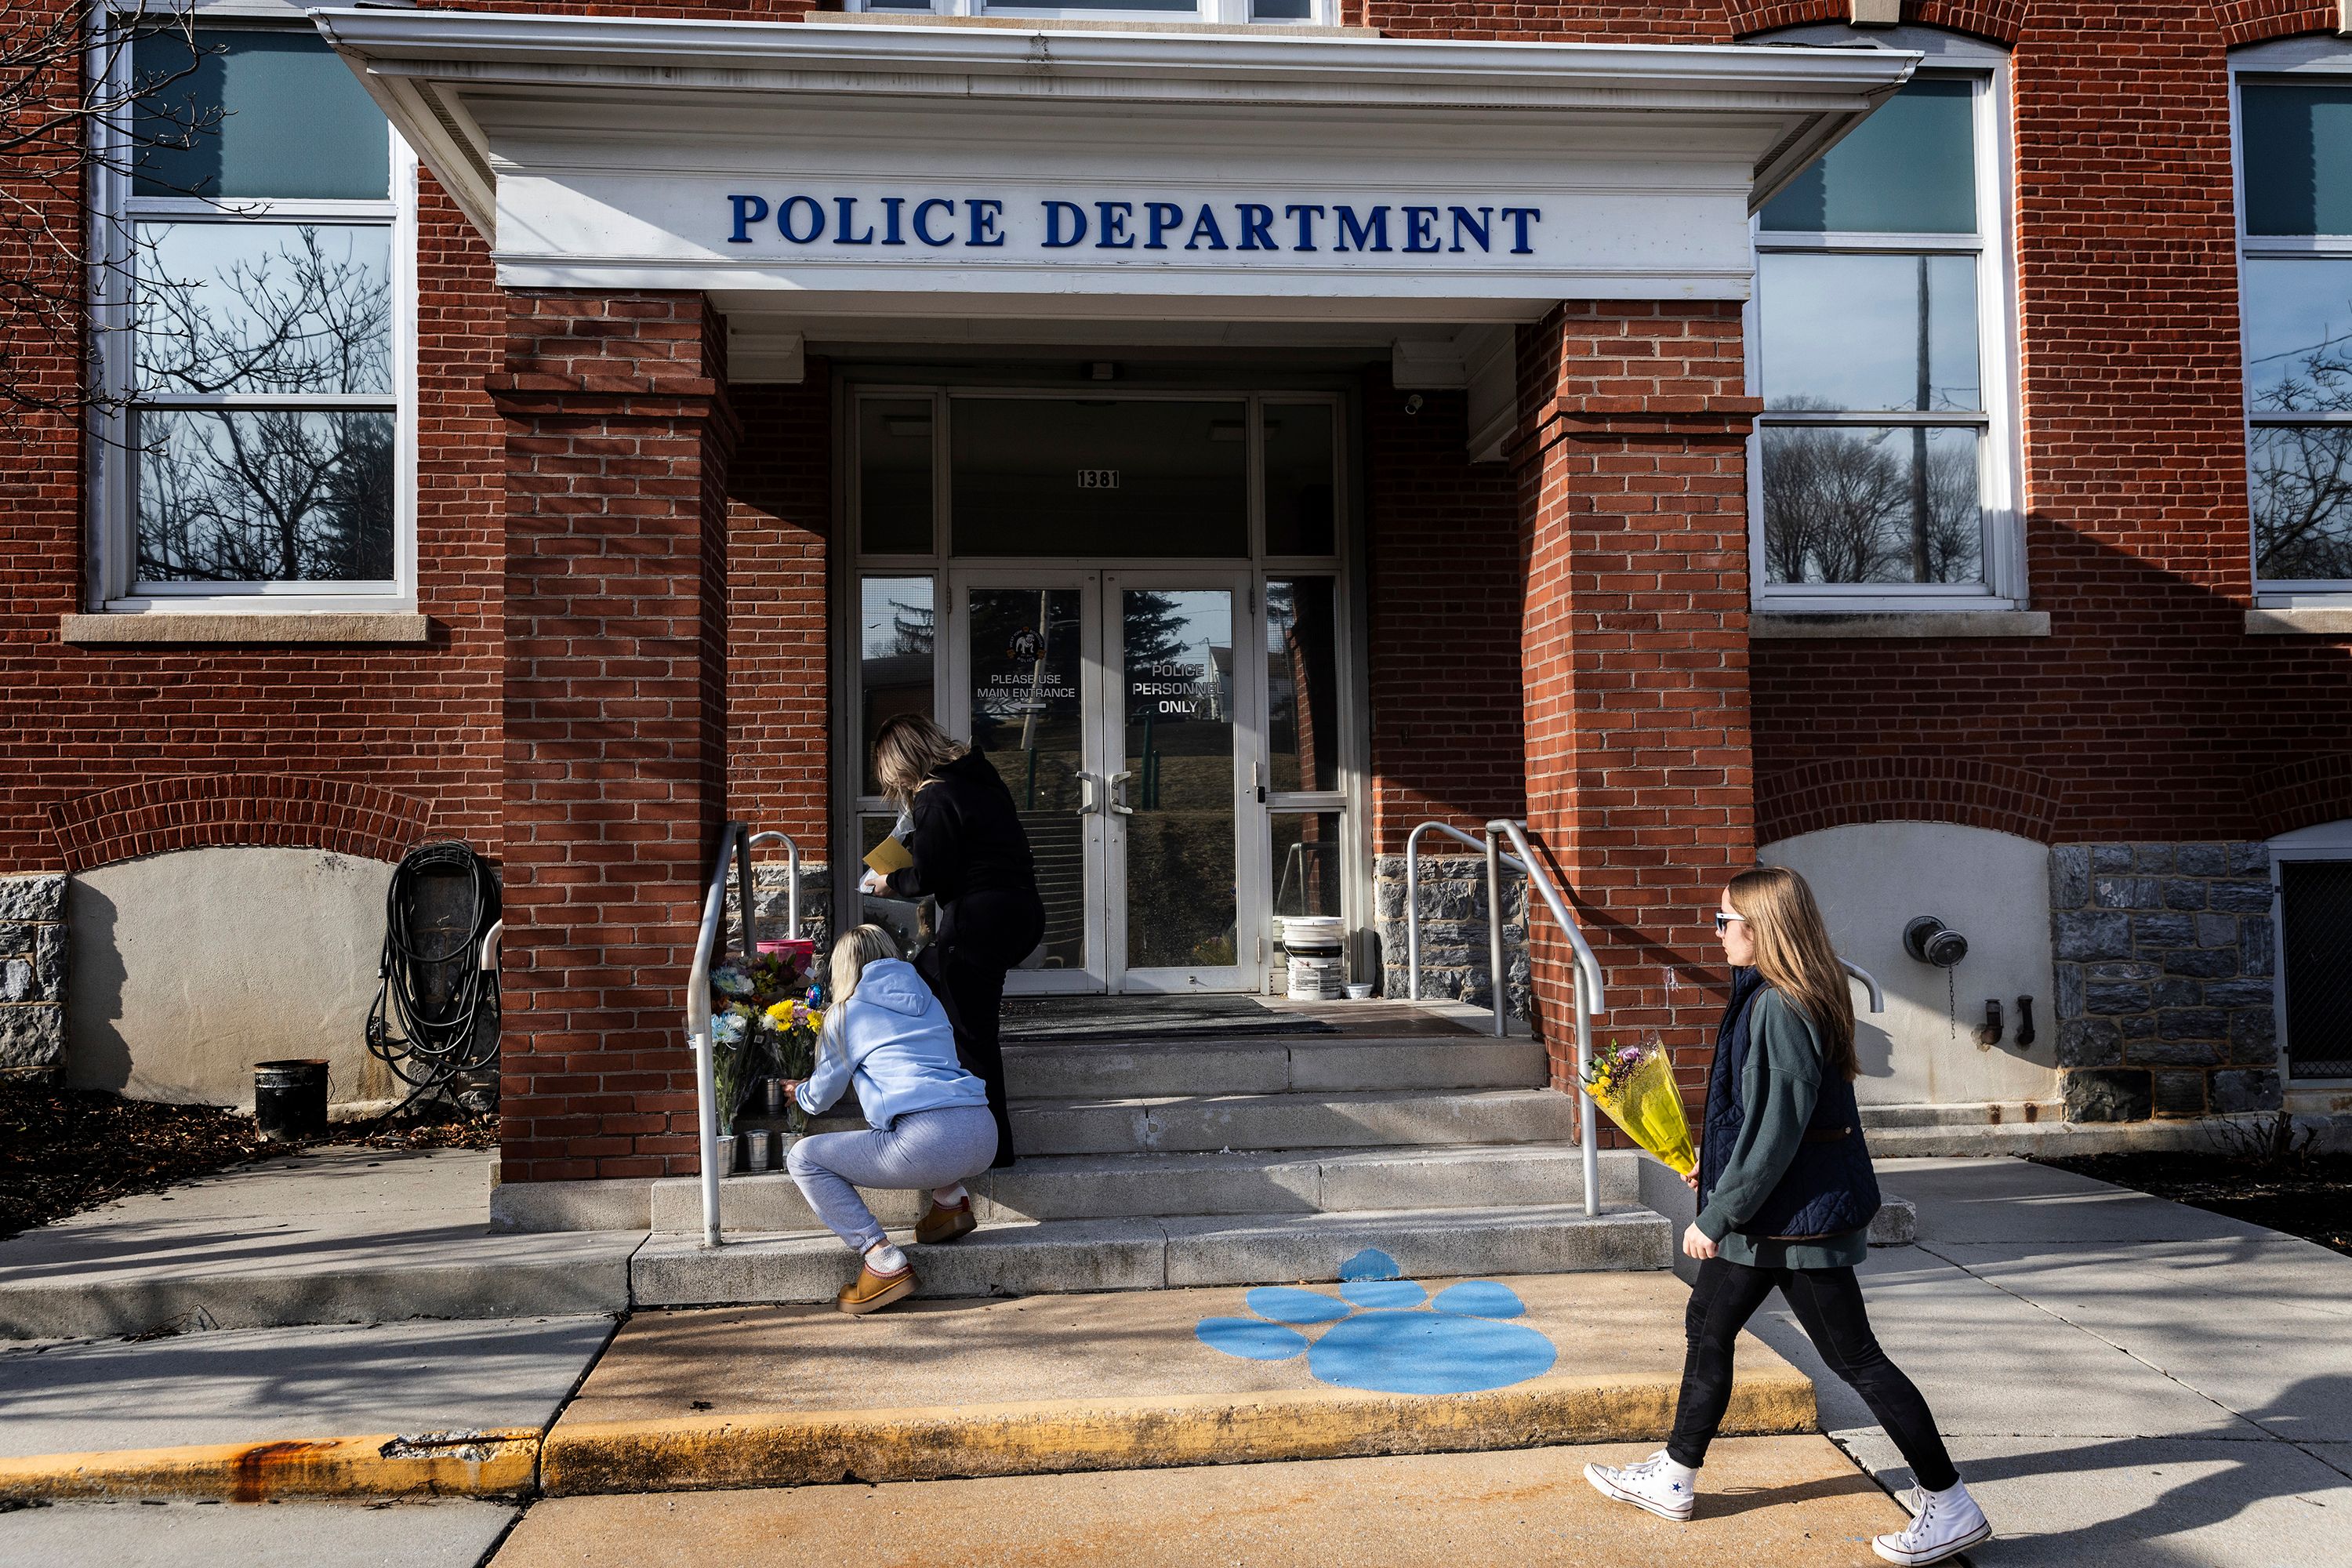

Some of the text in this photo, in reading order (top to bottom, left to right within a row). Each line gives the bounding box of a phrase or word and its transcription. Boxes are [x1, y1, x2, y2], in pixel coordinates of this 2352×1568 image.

[727, 194, 1541, 254] POLICE DEPARTMENT
[1079, 470, 1118, 487] 1381
[1152, 664, 1204, 677] POLICE
[991, 674, 1061, 684] PLEASE USE
[977, 688, 1076, 698] MAIN ENTRANCE
[1132, 683, 1225, 695] PERSONNEL
[1159, 700, 1199, 713] ONLY
